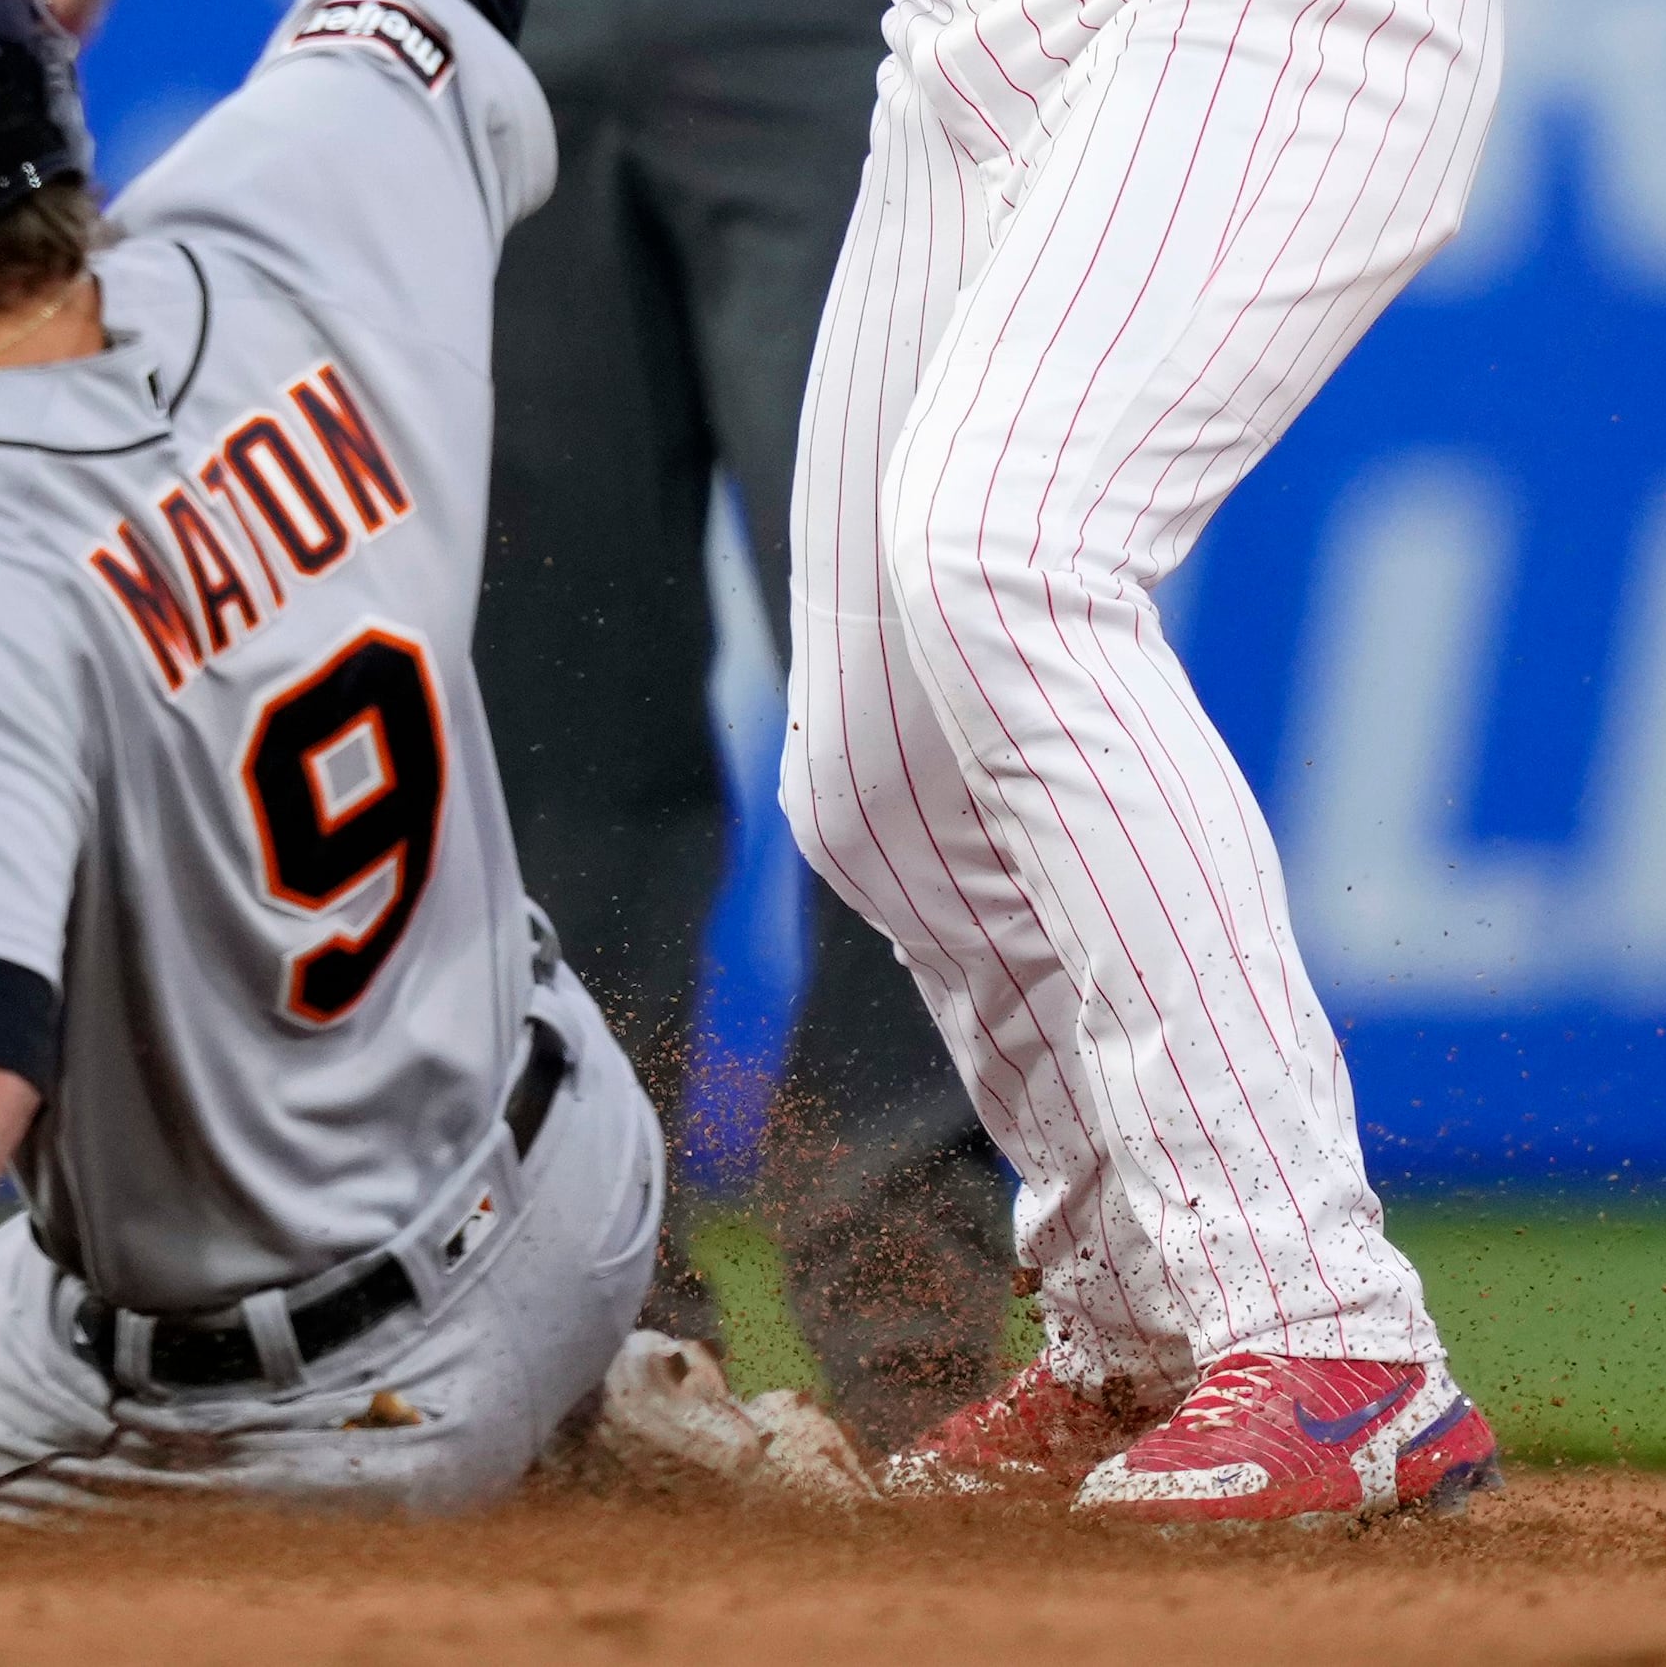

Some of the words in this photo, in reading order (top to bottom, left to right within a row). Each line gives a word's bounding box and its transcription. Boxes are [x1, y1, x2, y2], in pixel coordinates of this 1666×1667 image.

[303, 2, 445, 77] meijer
[89, 361, 413, 694] MATON
[241, 622, 445, 1024] 9
